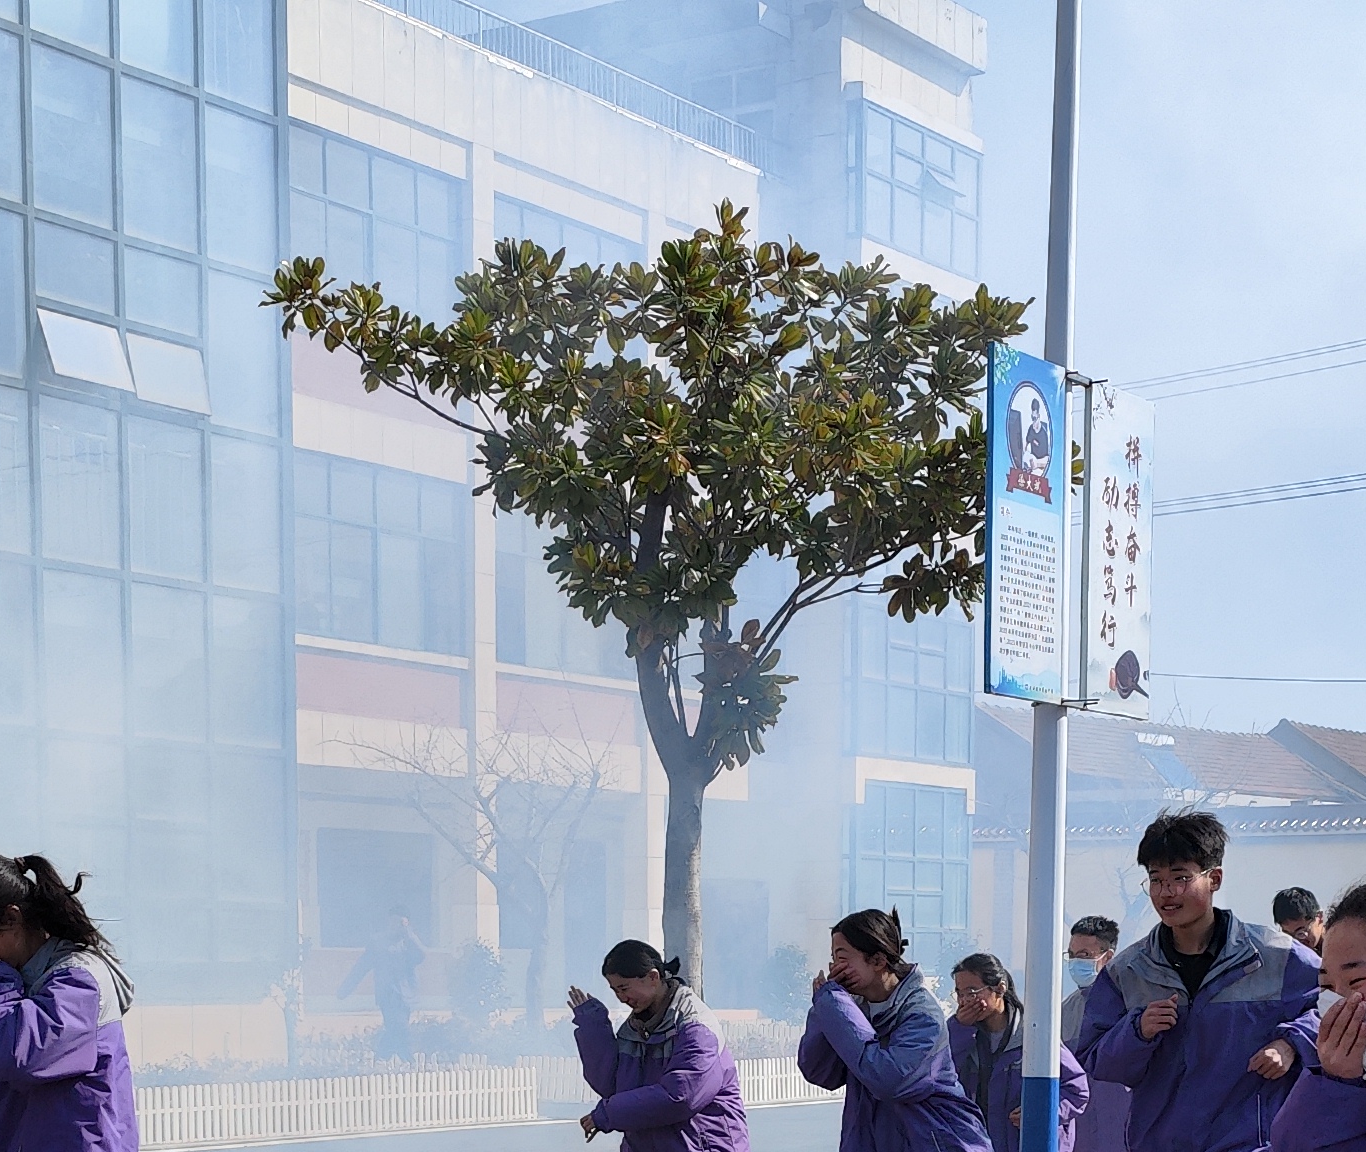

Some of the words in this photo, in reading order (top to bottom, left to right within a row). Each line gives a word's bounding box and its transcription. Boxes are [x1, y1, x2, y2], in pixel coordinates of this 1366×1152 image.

[1099, 476, 1120, 649] 励志笃行
[1123, 434, 1142, 608] 拼搏奋斗
